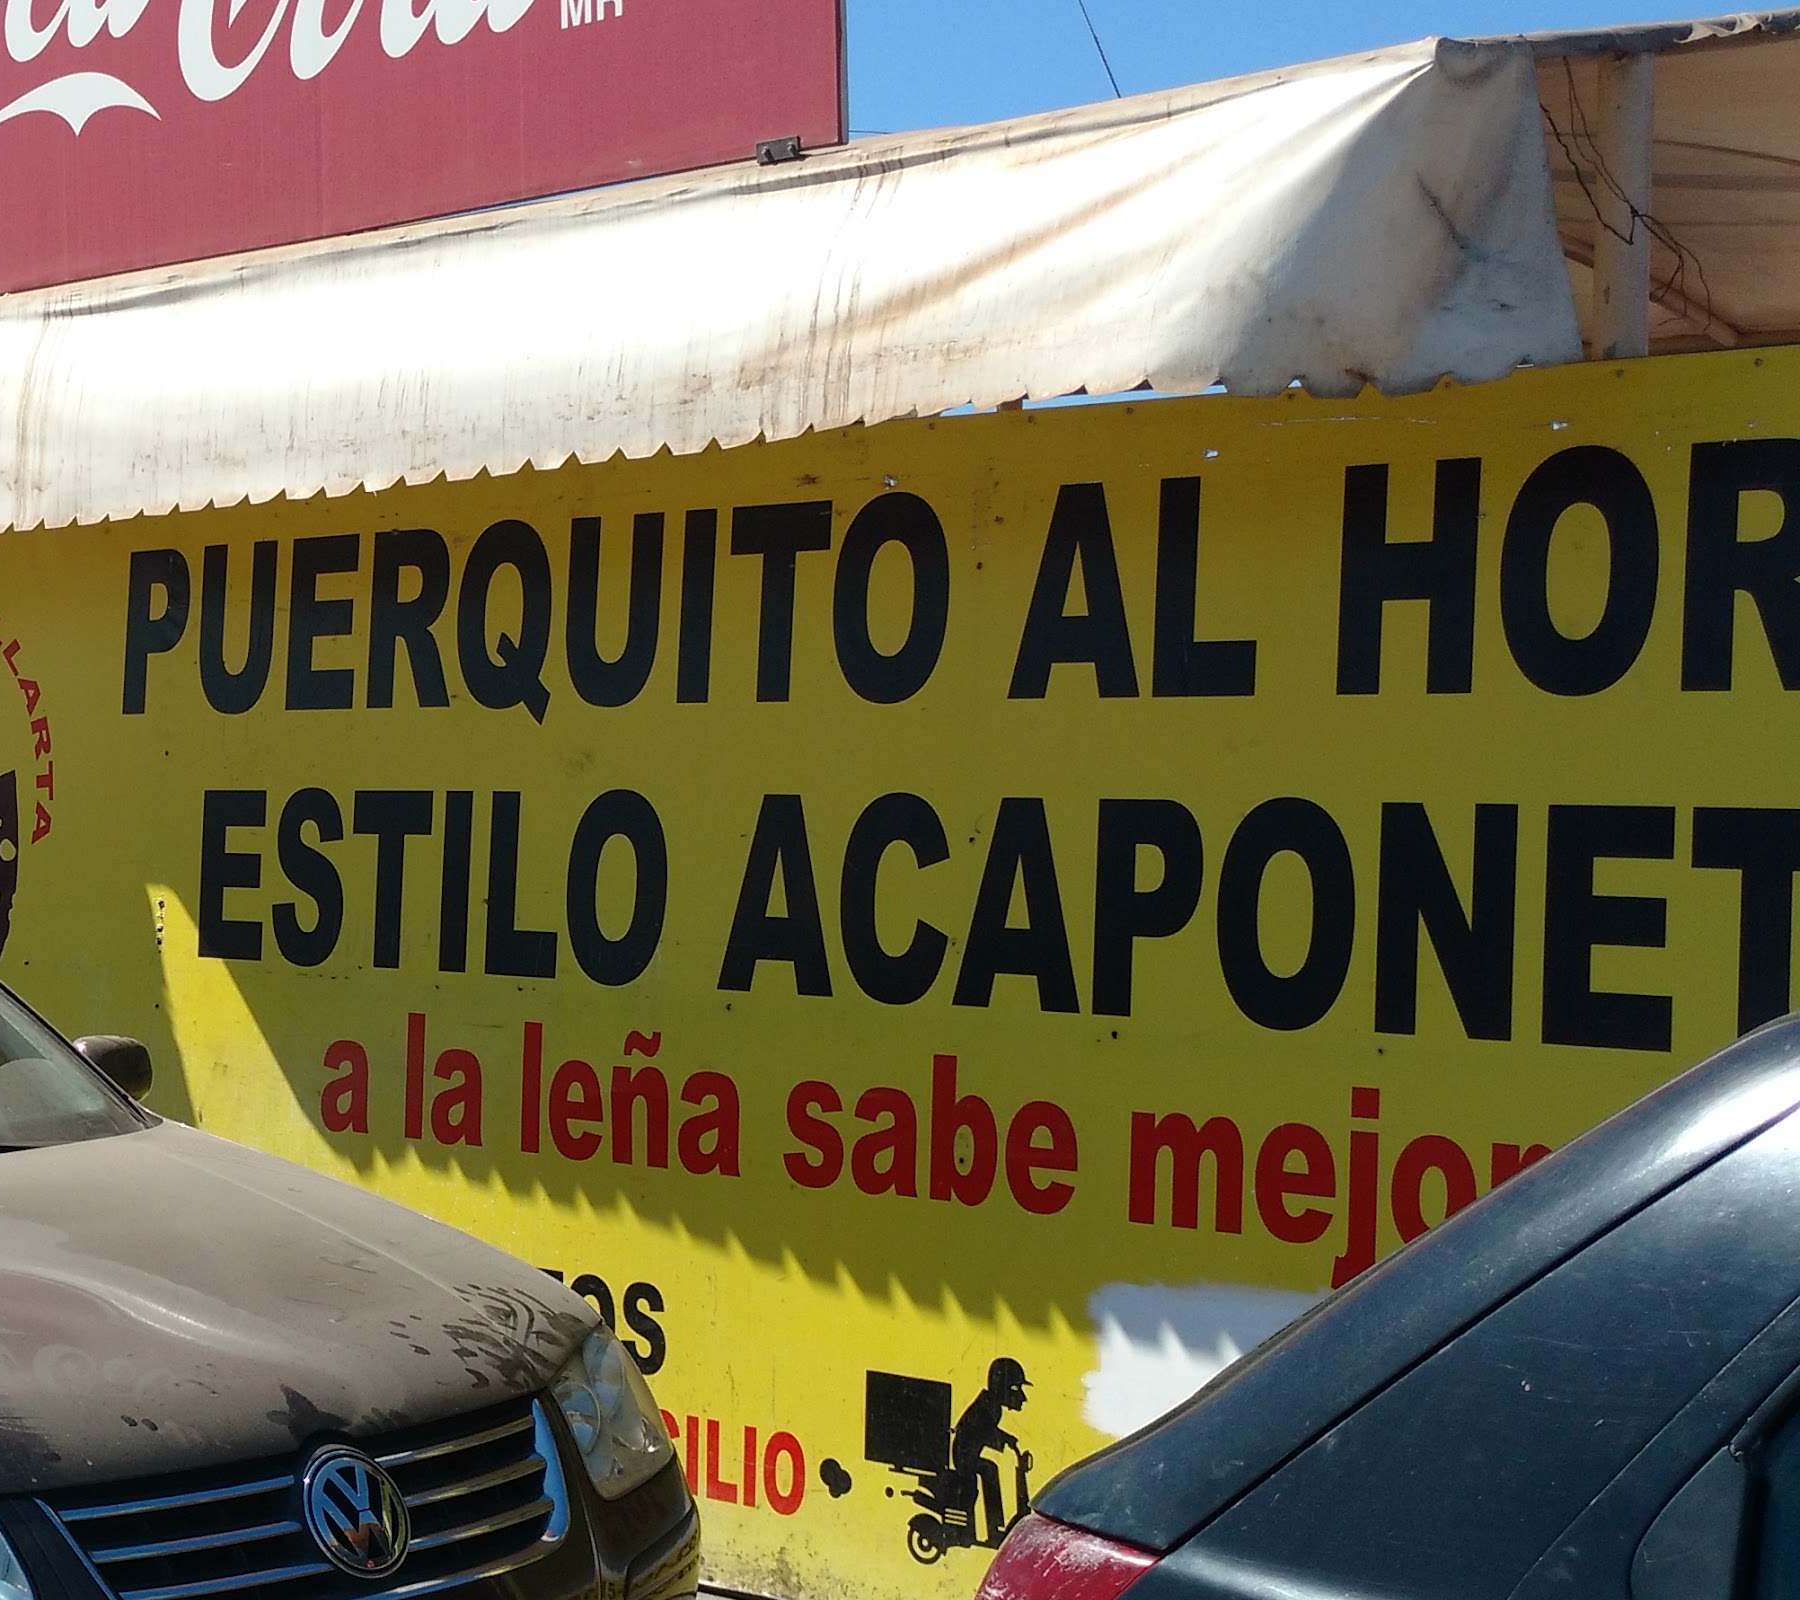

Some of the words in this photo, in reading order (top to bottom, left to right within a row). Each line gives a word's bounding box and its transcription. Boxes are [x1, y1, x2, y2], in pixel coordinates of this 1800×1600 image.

[122, 491, 950, 726] PUERQUITO
[1008, 476, 1257, 700] AL
[1336, 438, 1800, 697] HOR
[198, 788, 667, 987] ESTILO
[716, 791, 1800, 1053] ACAPONET
[320, 1039, 370, 1134] a
[404, 1012, 483, 1147] la
[520, 1021, 742, 1179] leña
[783, 1054, 1078, 1216] sabe
